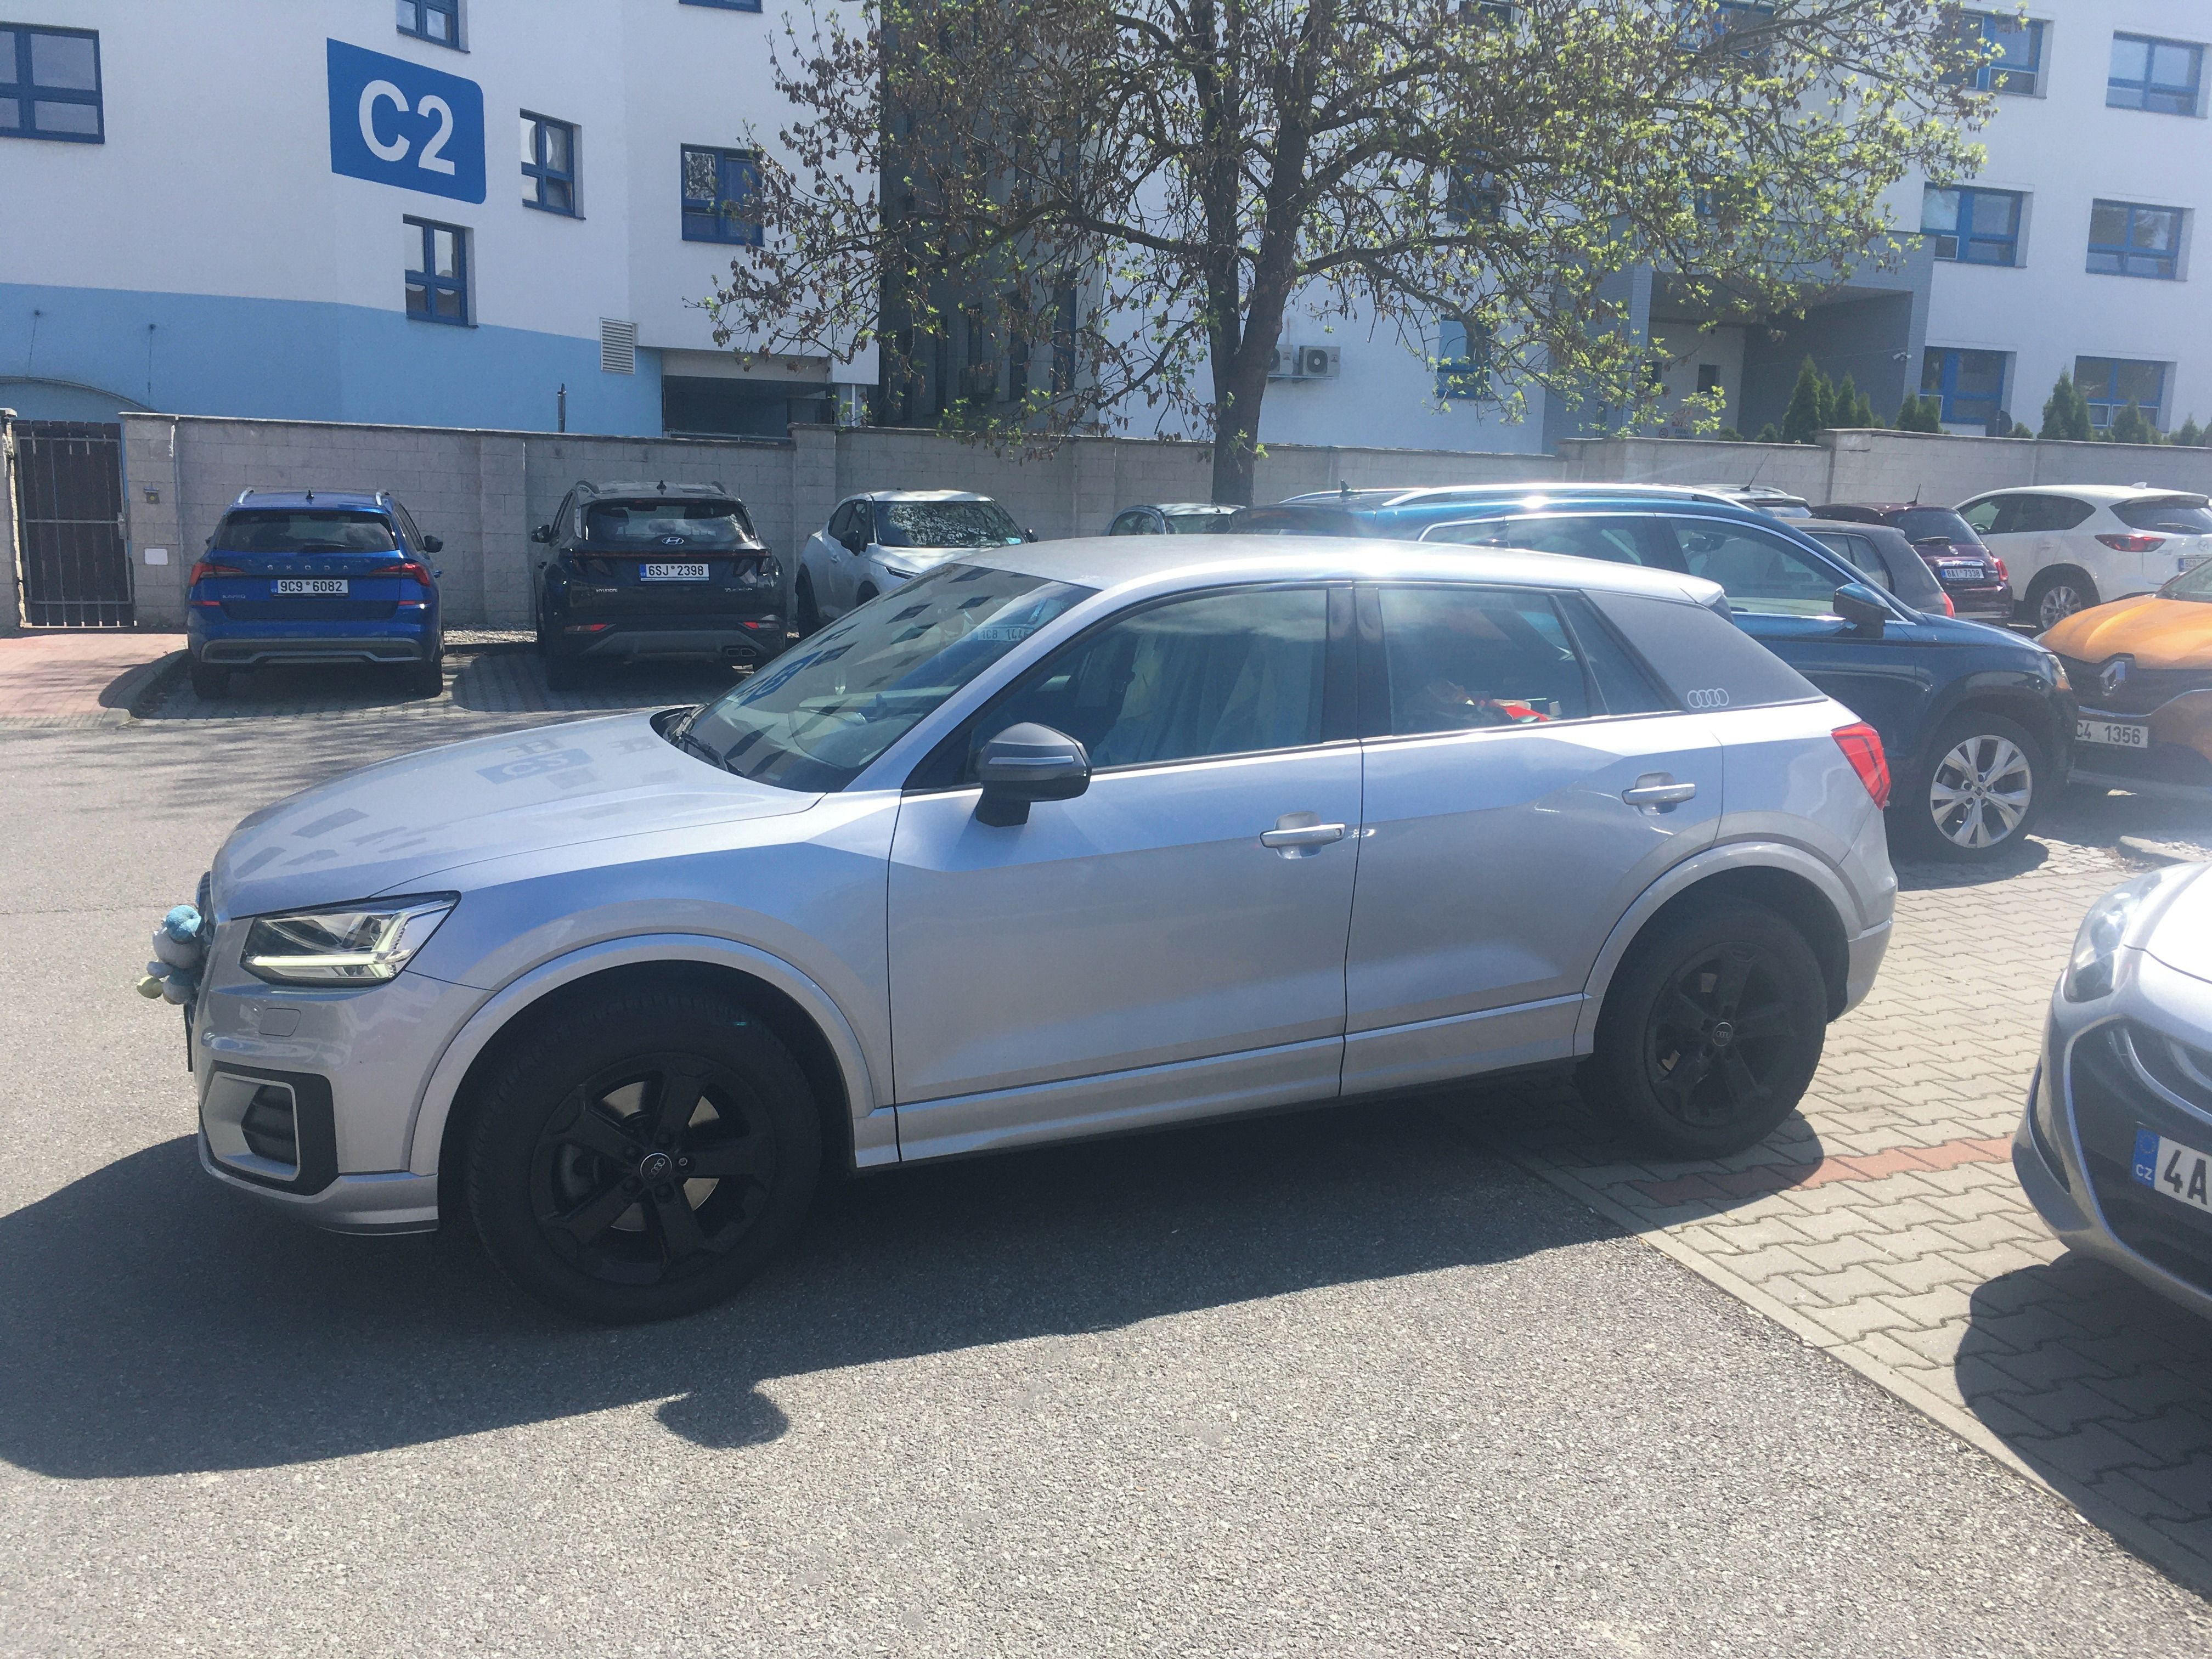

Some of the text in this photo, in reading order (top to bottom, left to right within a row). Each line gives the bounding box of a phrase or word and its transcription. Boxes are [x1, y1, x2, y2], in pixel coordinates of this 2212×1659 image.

[359, 80, 455, 176] C2
[648, 566, 703, 576] 6SJ 2398
[280, 581, 342, 591] 9C9 6082
[2105, 725, 2141, 744] 1356
[2136, 1164, 2153, 1181] CZ
[2164, 1150, 2208, 1205] 4A
